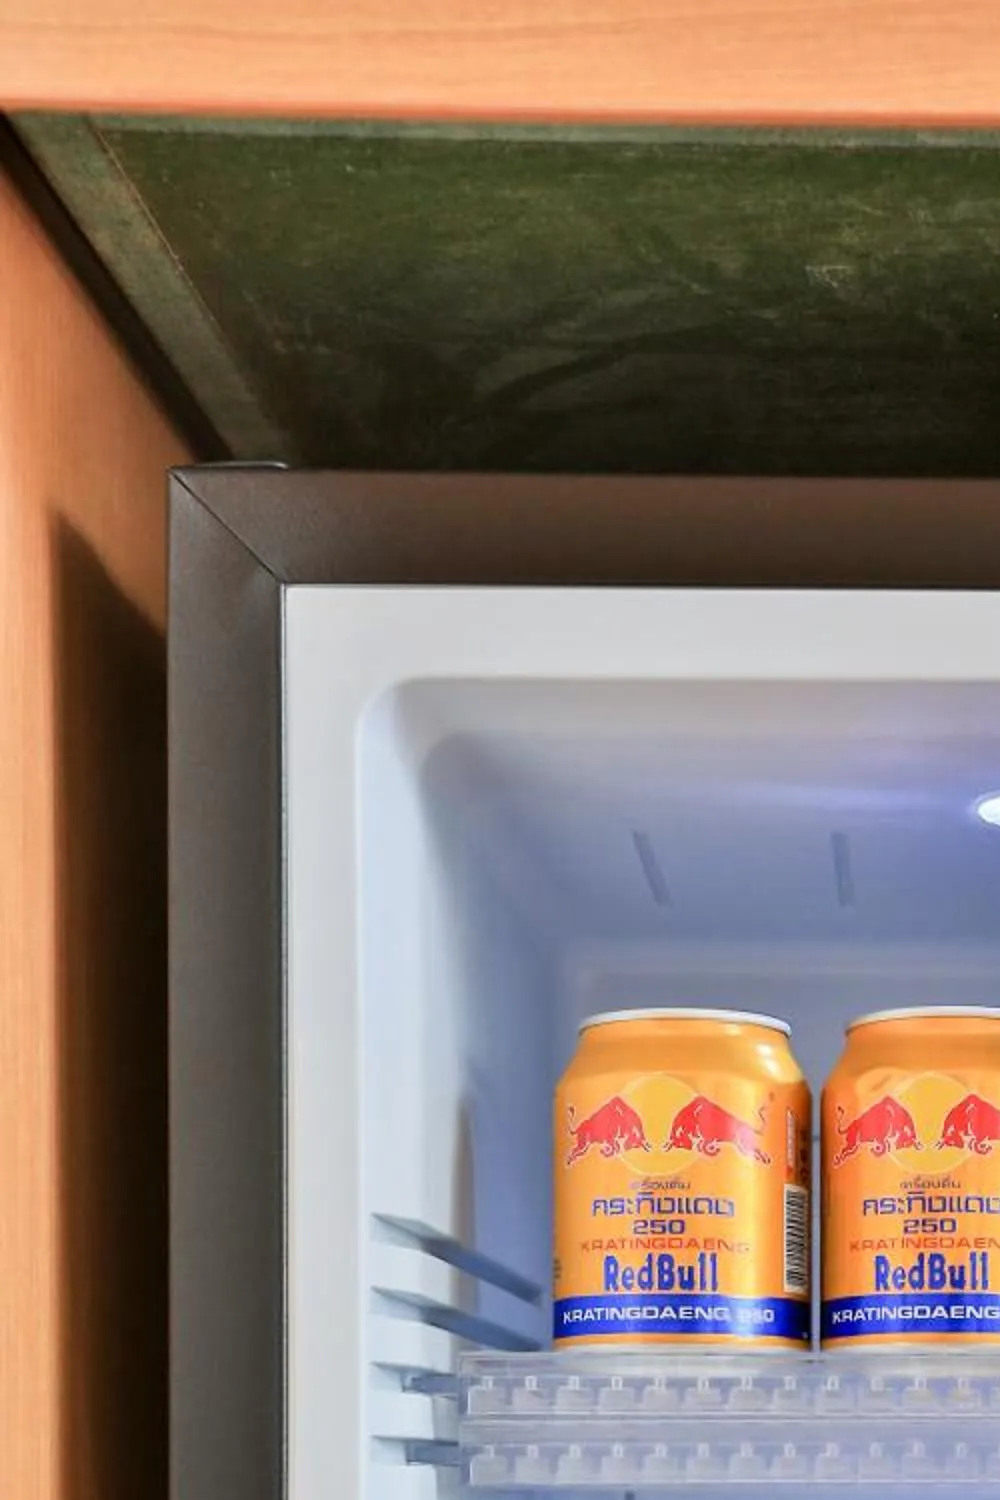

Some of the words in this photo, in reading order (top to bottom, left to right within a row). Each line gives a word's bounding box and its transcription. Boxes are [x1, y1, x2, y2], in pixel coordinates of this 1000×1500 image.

[633, 1219, 685, 1235] 250
[903, 1217, 957, 1233] 250
[603, 1252, 718, 1291] RedBull
[874, 1252, 989, 1291] RedBull
[563, 1306, 731, 1325] KRATINGDAENG
[831, 1305, 1000, 1325] KRATINGDAENG
